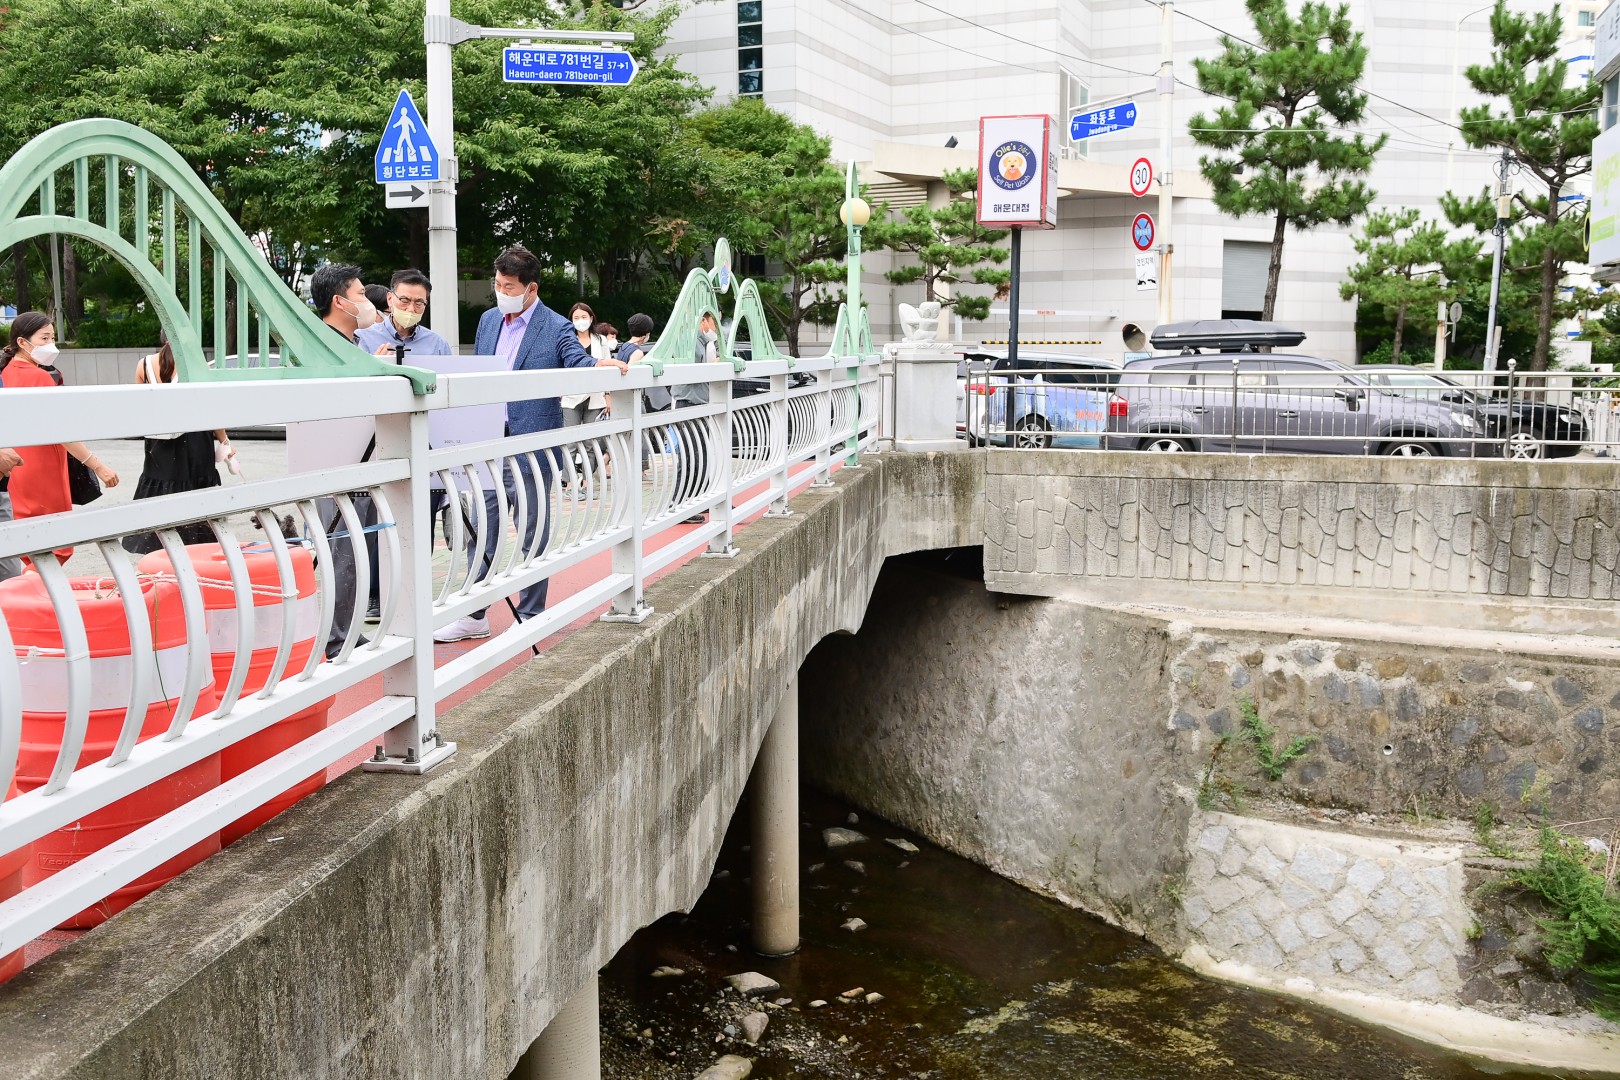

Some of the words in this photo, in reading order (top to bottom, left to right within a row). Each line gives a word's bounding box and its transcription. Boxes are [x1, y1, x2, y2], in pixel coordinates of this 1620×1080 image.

[508, 69, 562, 79] Haeun-daero
[565, 71, 613, 82] 781beon-gil
[1089, 108, 1117, 124] 좌동로
[1126, 110, 1135, 119] 69
[382, 165, 433, 179] 횡단보도
[1135, 167, 1147, 186] 30
[993, 174, 1005, 186] Self
[1004, 181, 1014, 189] Pet
[1014, 175, 1031, 188] Wash
[993, 203, 1030, 213] 해운대점
